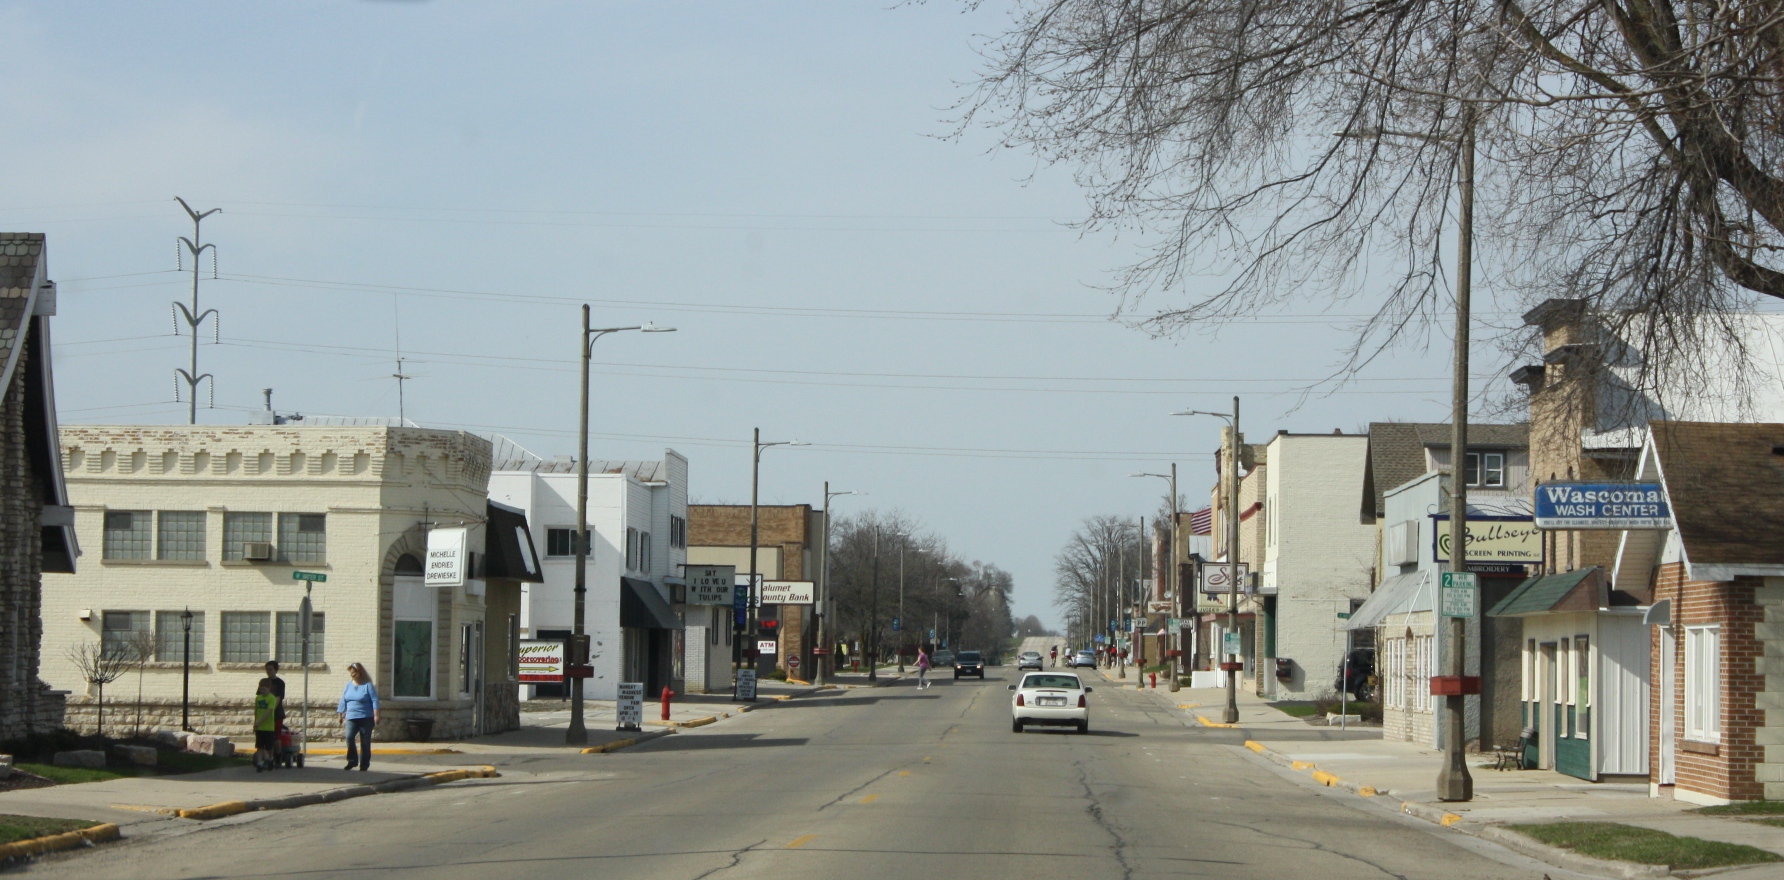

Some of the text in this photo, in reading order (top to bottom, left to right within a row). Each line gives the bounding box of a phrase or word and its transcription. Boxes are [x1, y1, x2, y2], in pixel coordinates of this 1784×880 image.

[1555, 504, 1658, 516] WASH CENTER
[1464, 524, 1540, 546] Bullseye
[1444, 574, 1450, 587] 2
[519, 644, 558, 657] uperior
[518, 656, 559, 664] oorcovering
